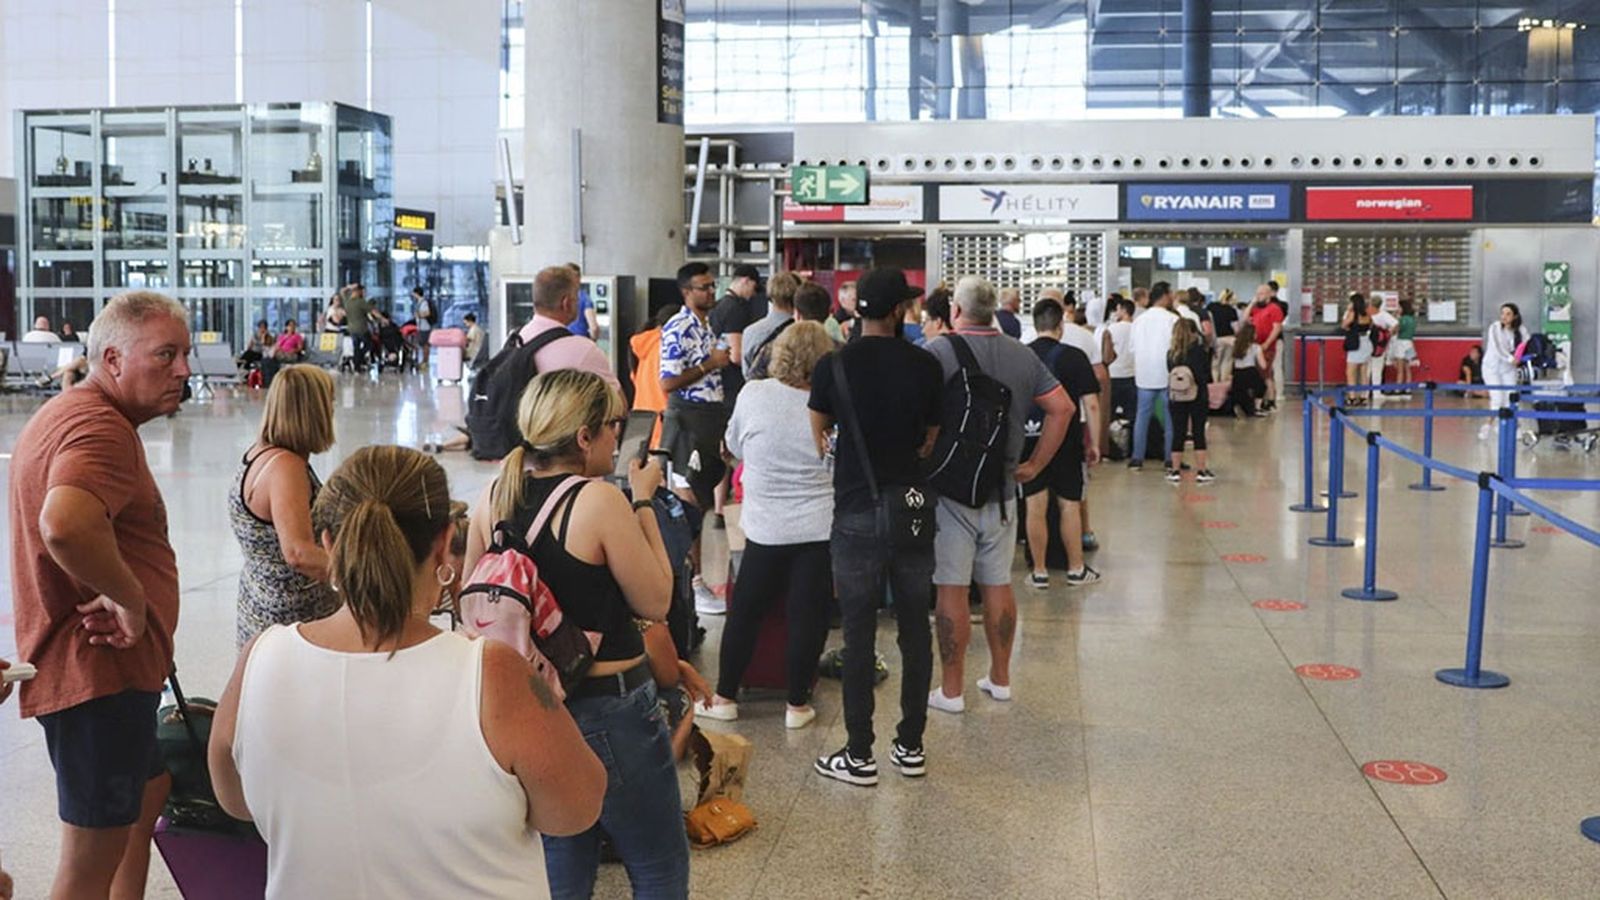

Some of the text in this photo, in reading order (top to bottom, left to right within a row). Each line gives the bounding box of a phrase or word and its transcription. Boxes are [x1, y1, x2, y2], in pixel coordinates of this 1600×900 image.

[1006, 194, 1080, 211] HÉLITY
[1153, 195, 1243, 209] RYANAIR
[1356, 197, 1422, 209] norwegian
